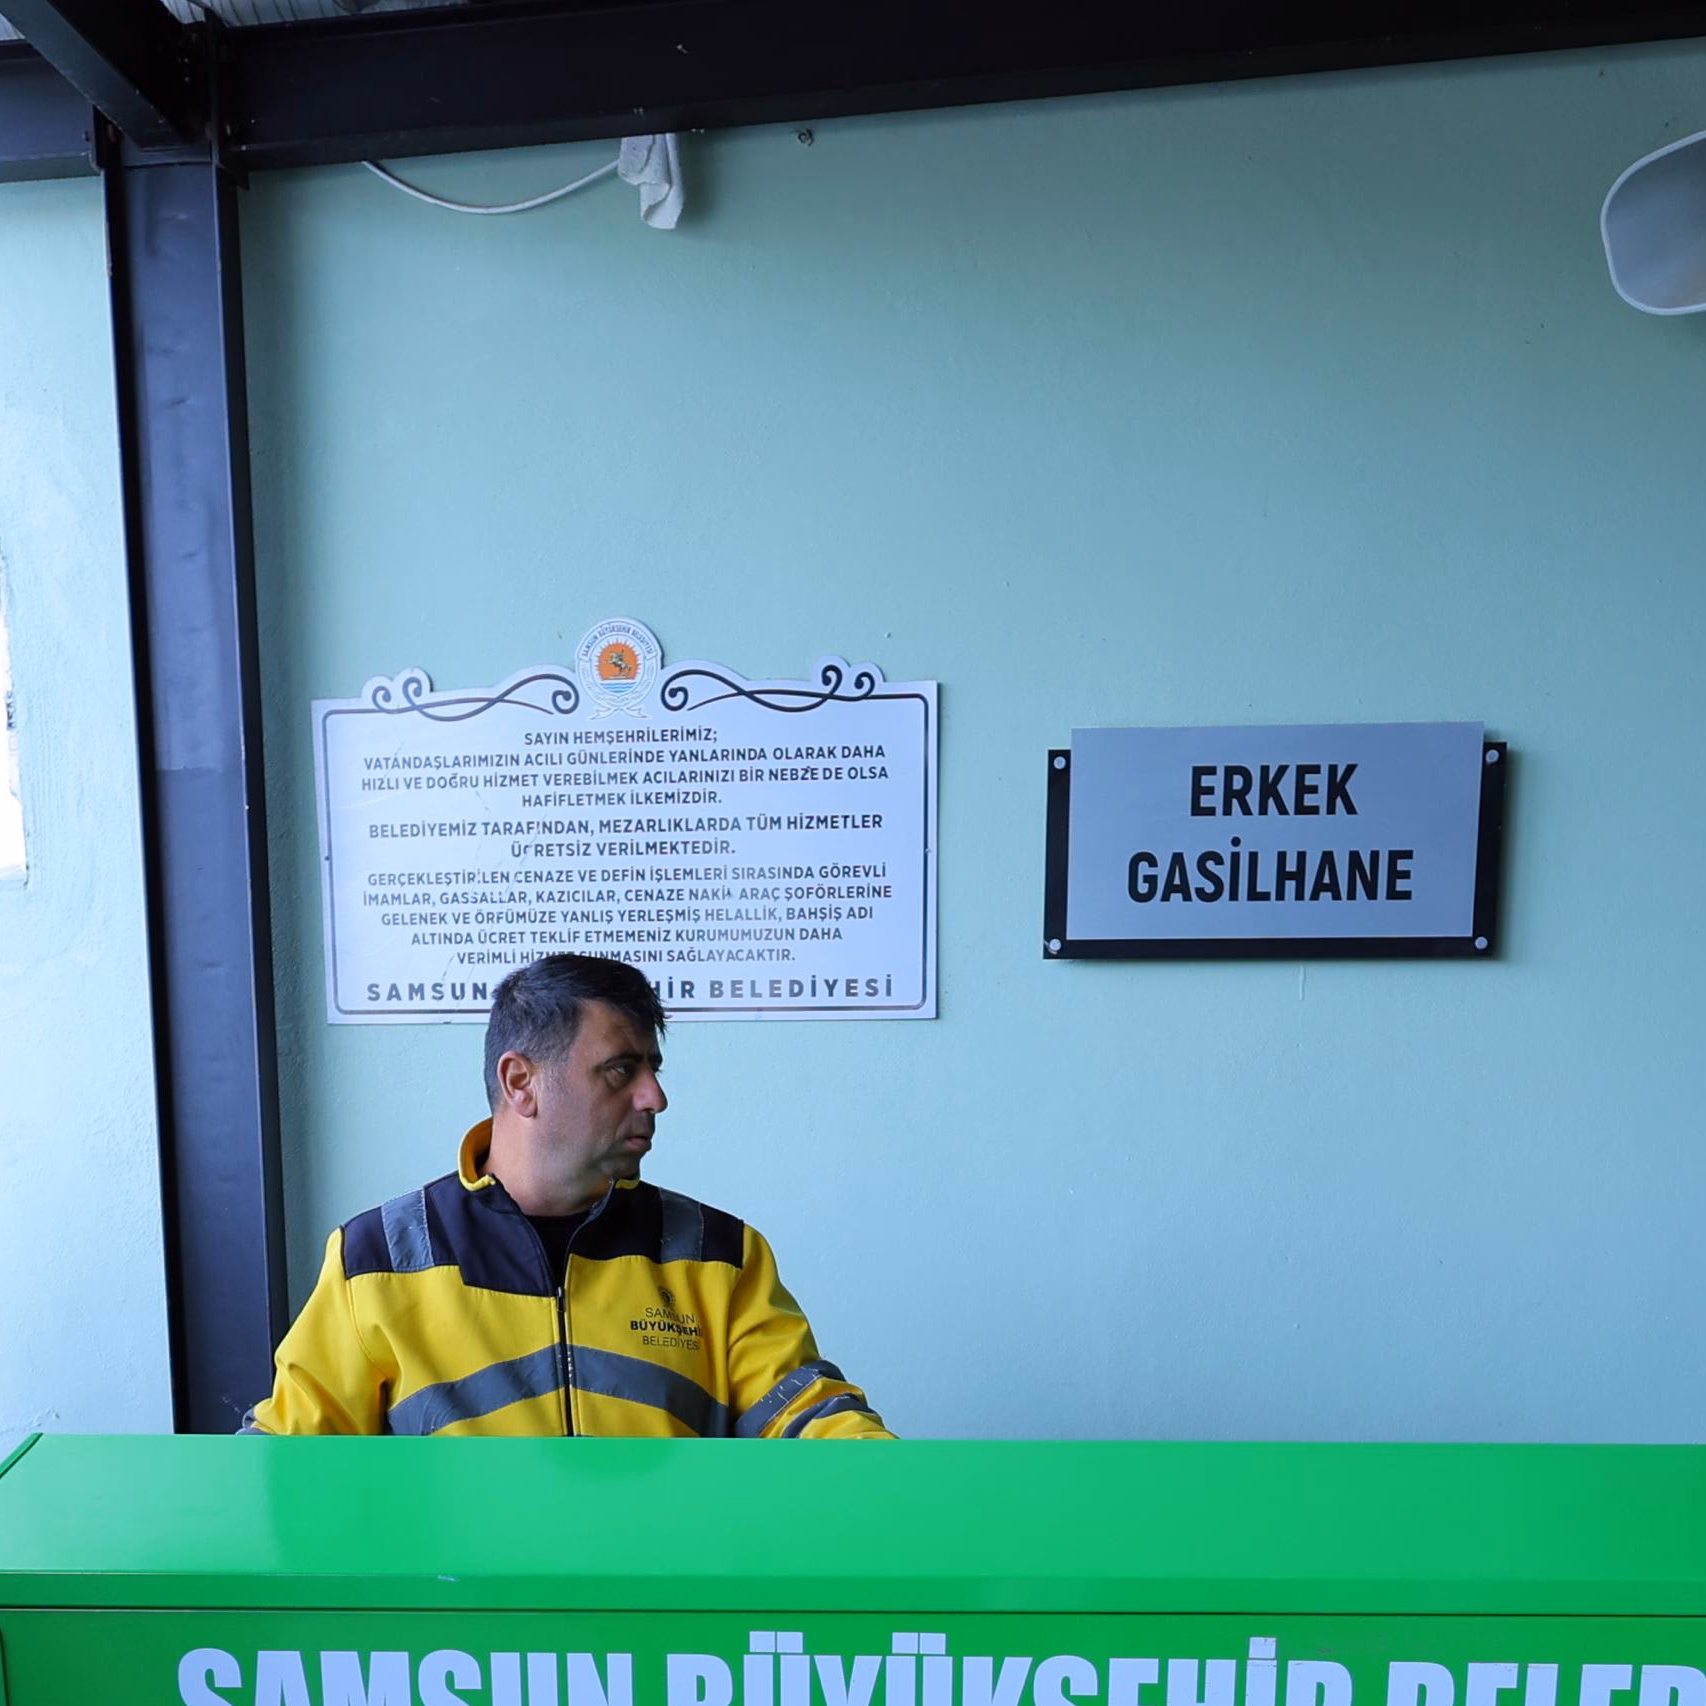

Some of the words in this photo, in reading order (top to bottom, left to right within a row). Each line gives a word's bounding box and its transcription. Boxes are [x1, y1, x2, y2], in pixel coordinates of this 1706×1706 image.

[524, 731, 569, 746] SAYIN
[573, 727, 717, 745] HEMŞEHRİLERİMİZ;
[363, 754, 520, 771] VATANDAŞLARIMIZIN
[524, 752, 562, 767] ACILI
[567, 749, 665, 765] GÜNLERİNDE
[669, 748, 767, 763] YANLARINDA
[773, 746, 837, 760] OLARAK
[841, 745, 885, 759] DAHA
[361, 777, 399, 791] HIZLI
[403, 776, 423, 790] VE
[426, 773, 479, 790] DOĞRU
[483, 773, 539, 789] HİZMET
[543, 771, 638, 787] VEREBİLMEK
[643, 769, 735, 784] ACILARINIZI
[739, 766, 764, 782] BİR
[822, 767, 843, 780] DE
[847, 766, 889, 780] OLSA
[1190, 763, 1358, 817] ERKEK
[522, 791, 626, 807] HAFİFLETMEK
[630, 789, 723, 805] İLKEMİZDİR.
[369, 819, 477, 838] BELEDİYEMİZ
[599, 817, 742, 834] MEZARLIKLARDA
[746, 813, 782, 831] TÜM
[786, 812, 883, 831] HİZMETLER
[596, 838, 736, 857] VERİLMEKTEDİR.
[514, 870, 574, 883] CENAZE
[578, 869, 597, 882] VE
[601, 866, 644, 882] DEFİN
[650, 864, 728, 882] İŞLEMLERİ
[731, 866, 815, 880] SIRASINDA
[818, 862, 886, 879] GÖREVLİ
[1127, 836, 1414, 903] GASİLHANE
[363, 891, 436, 907] İMAMLAR,
[536, 889, 620, 904] KAZICILAR,
[624, 888, 685, 902] CENAZE
[739, 887, 780, 901] ARAÇ
[784, 883, 892, 900] ŞOFÖRLERİNE
[381, 912, 448, 926] GELENEK
[452, 912, 471, 925] VE
[475, 908, 556, 924] ÖRFÜMÜZE
[560, 910, 613, 925] YANLIŞ
[618, 907, 701, 923] YERLEŞMİŞ
[705, 905, 783, 921] HELALLİK,
[786, 904, 842, 921] BAHŞİŞ
[846, 906, 873, 919] ADI
[411, 932, 473, 945] ALTINDA
[478, 929, 526, 944] ÜCRET
[530, 927, 581, 943] TEKLİF
[584, 926, 671, 943] ETMEMENİZ
[675, 928, 794, 942] KURUMUMUZUN
[799, 927, 843, 940] DAHA
[457, 948, 516, 964] VERİMLİ
[667, 946, 795, 963] SAĞLAYACAKTIR.
[367, 982, 487, 1001] SAMSUN
[709, 974, 892, 998] BELEDİYESİ
